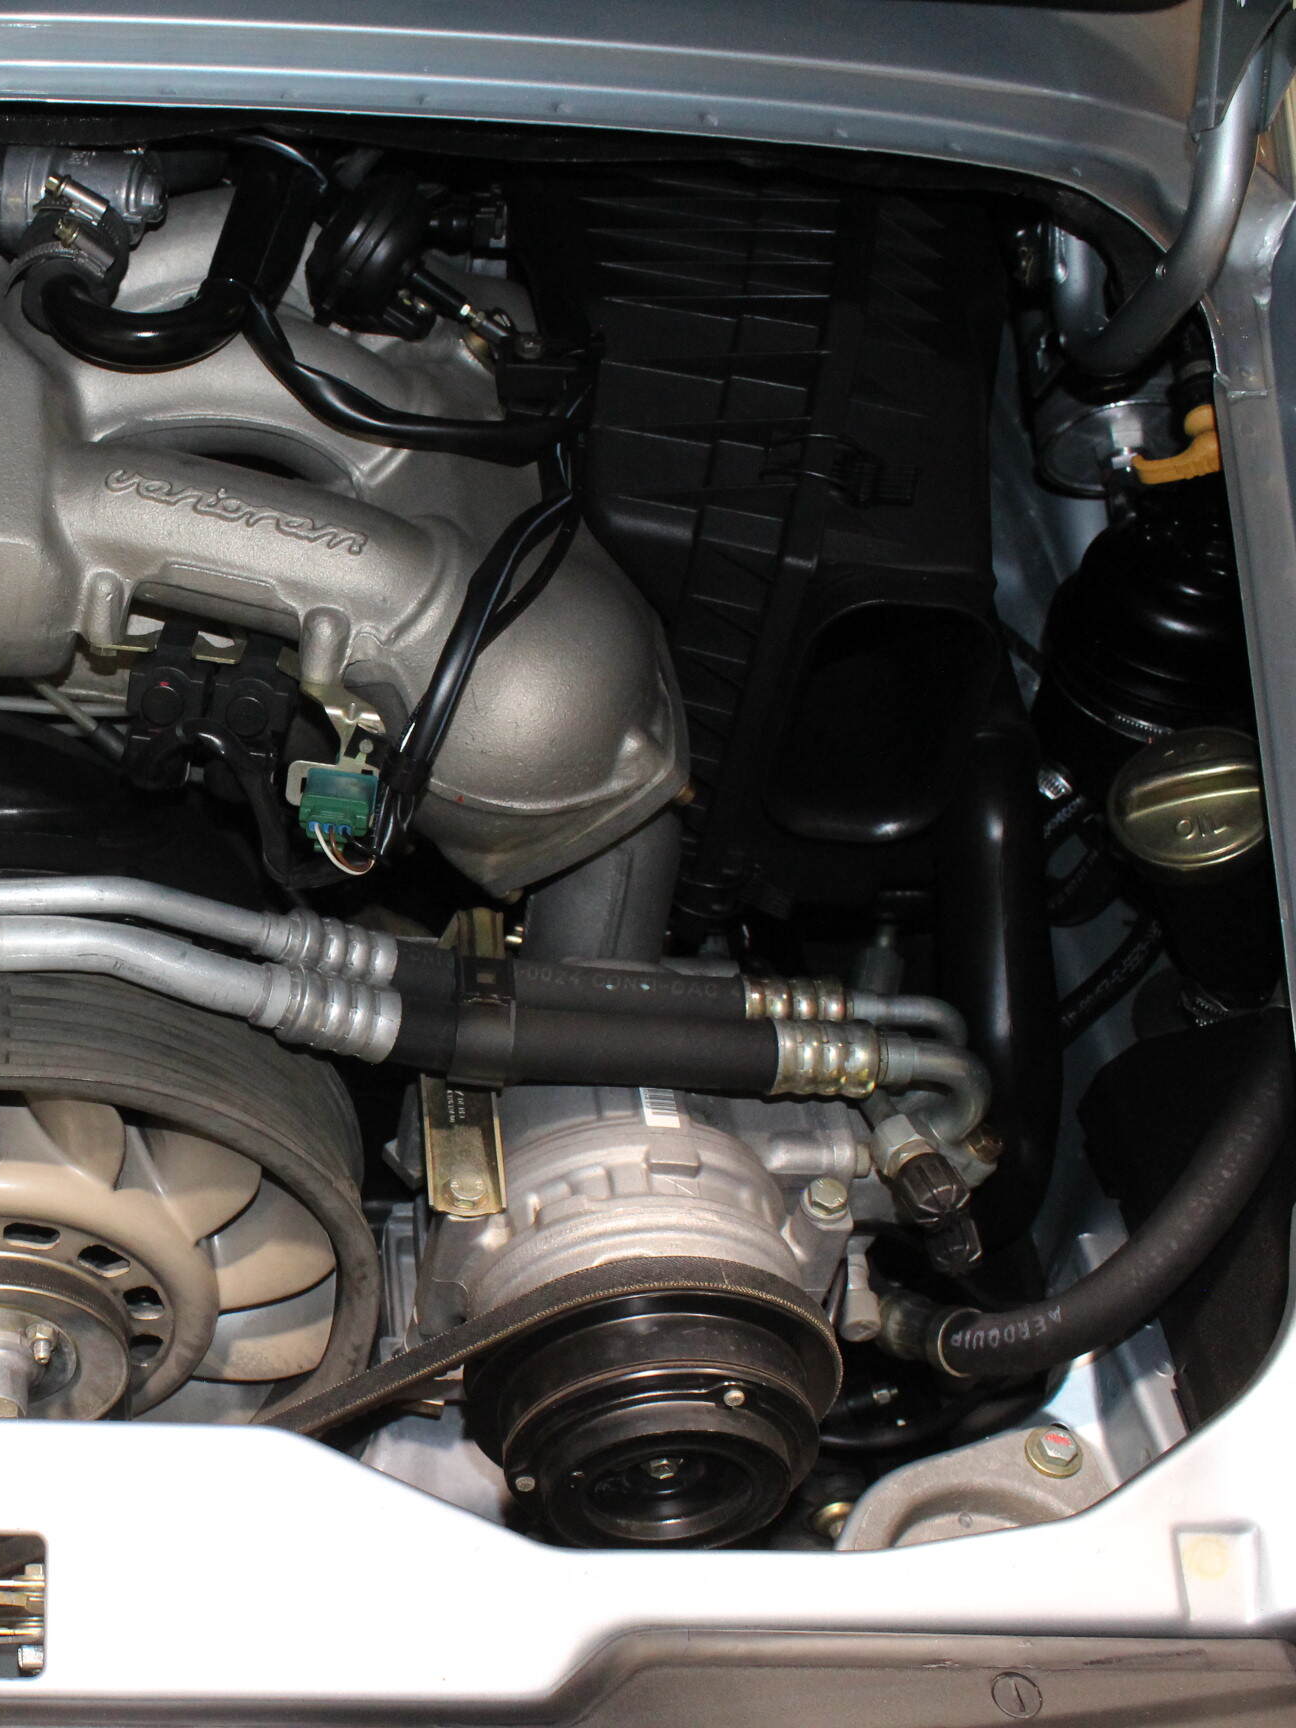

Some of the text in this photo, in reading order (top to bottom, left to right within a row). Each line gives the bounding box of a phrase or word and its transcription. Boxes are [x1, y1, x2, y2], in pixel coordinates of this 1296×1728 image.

[105, 468, 367, 555] varioram
[1175, 814, 1229, 841] OIL
[950, 1305, 1062, 1349] AEROQUIP
